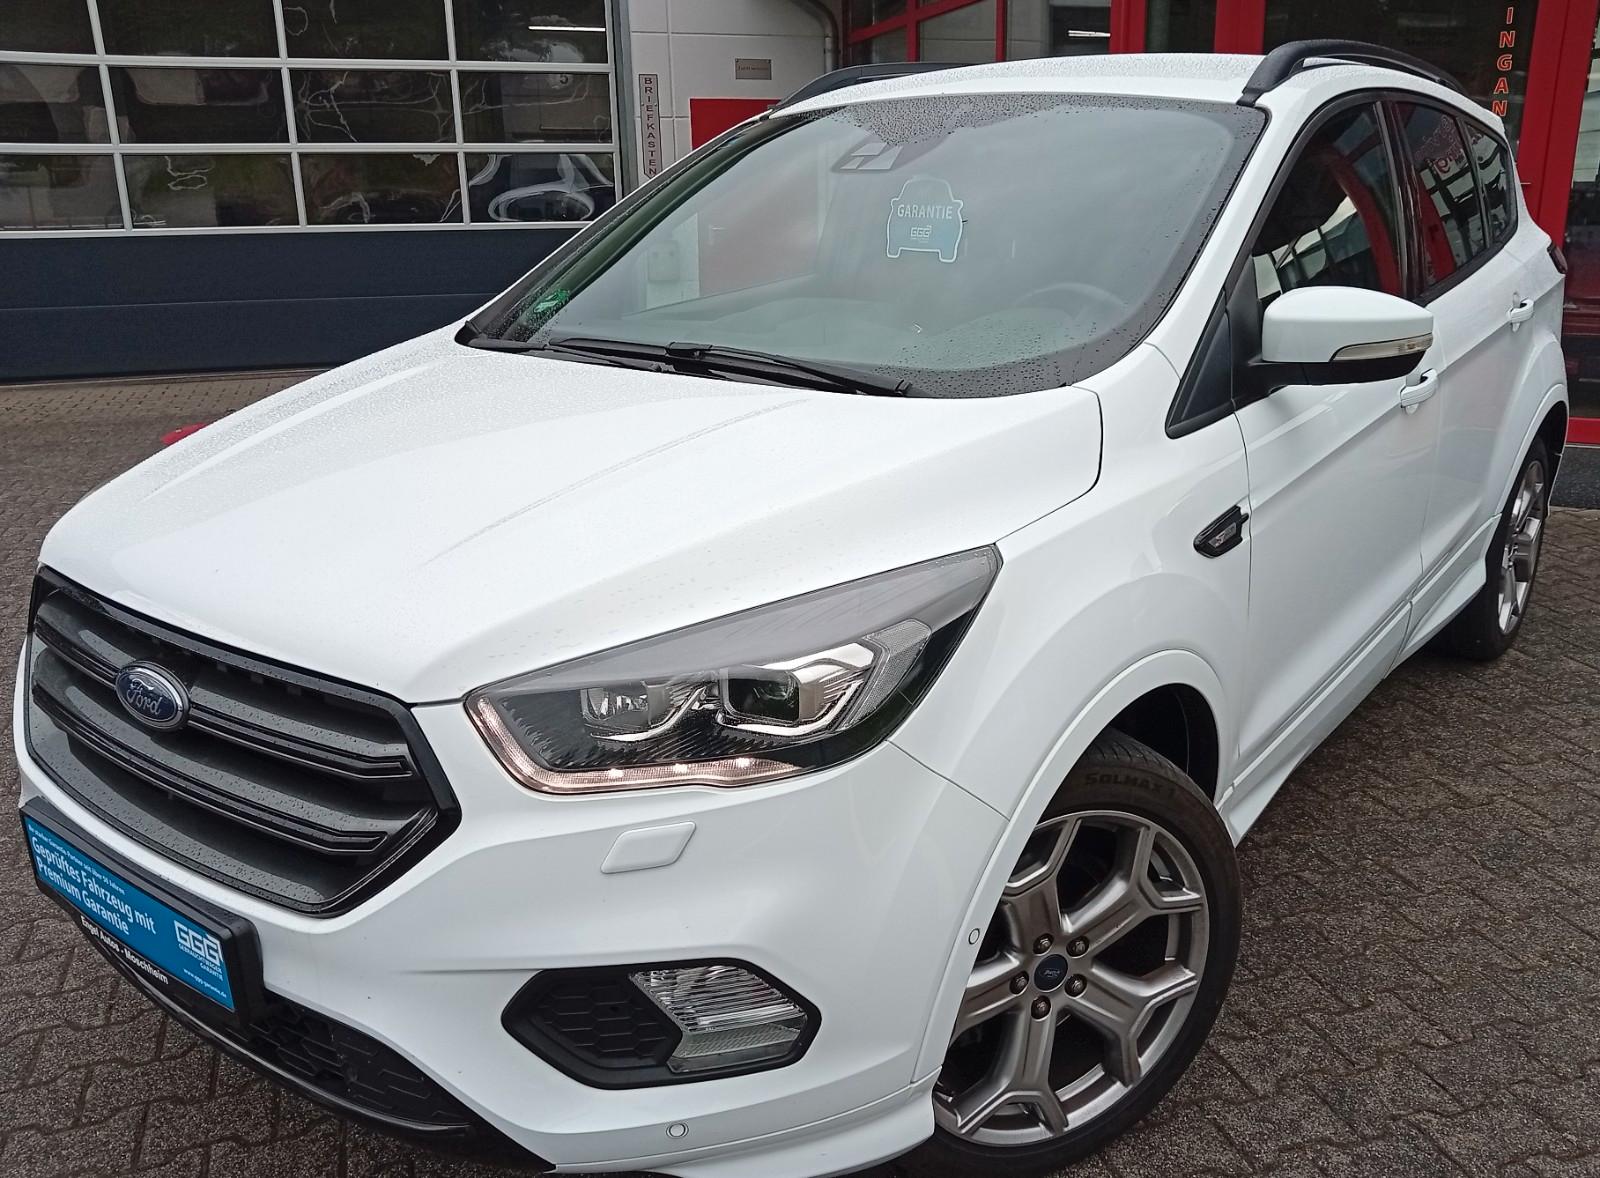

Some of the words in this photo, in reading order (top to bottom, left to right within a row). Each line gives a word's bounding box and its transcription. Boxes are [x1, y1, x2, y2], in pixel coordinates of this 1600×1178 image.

[644, 77, 657, 175] BRIEFKASTEN
[897, 204, 953, 219] GARANTIE
[126, 678, 163, 715] Ford
[32, 836, 81, 883] Geprüftes
[81, 870, 134, 923] Fahrzeug
[134, 910, 156, 934] mit
[36, 856, 82, 902] Premium
[82, 890, 130, 935] Garantie
